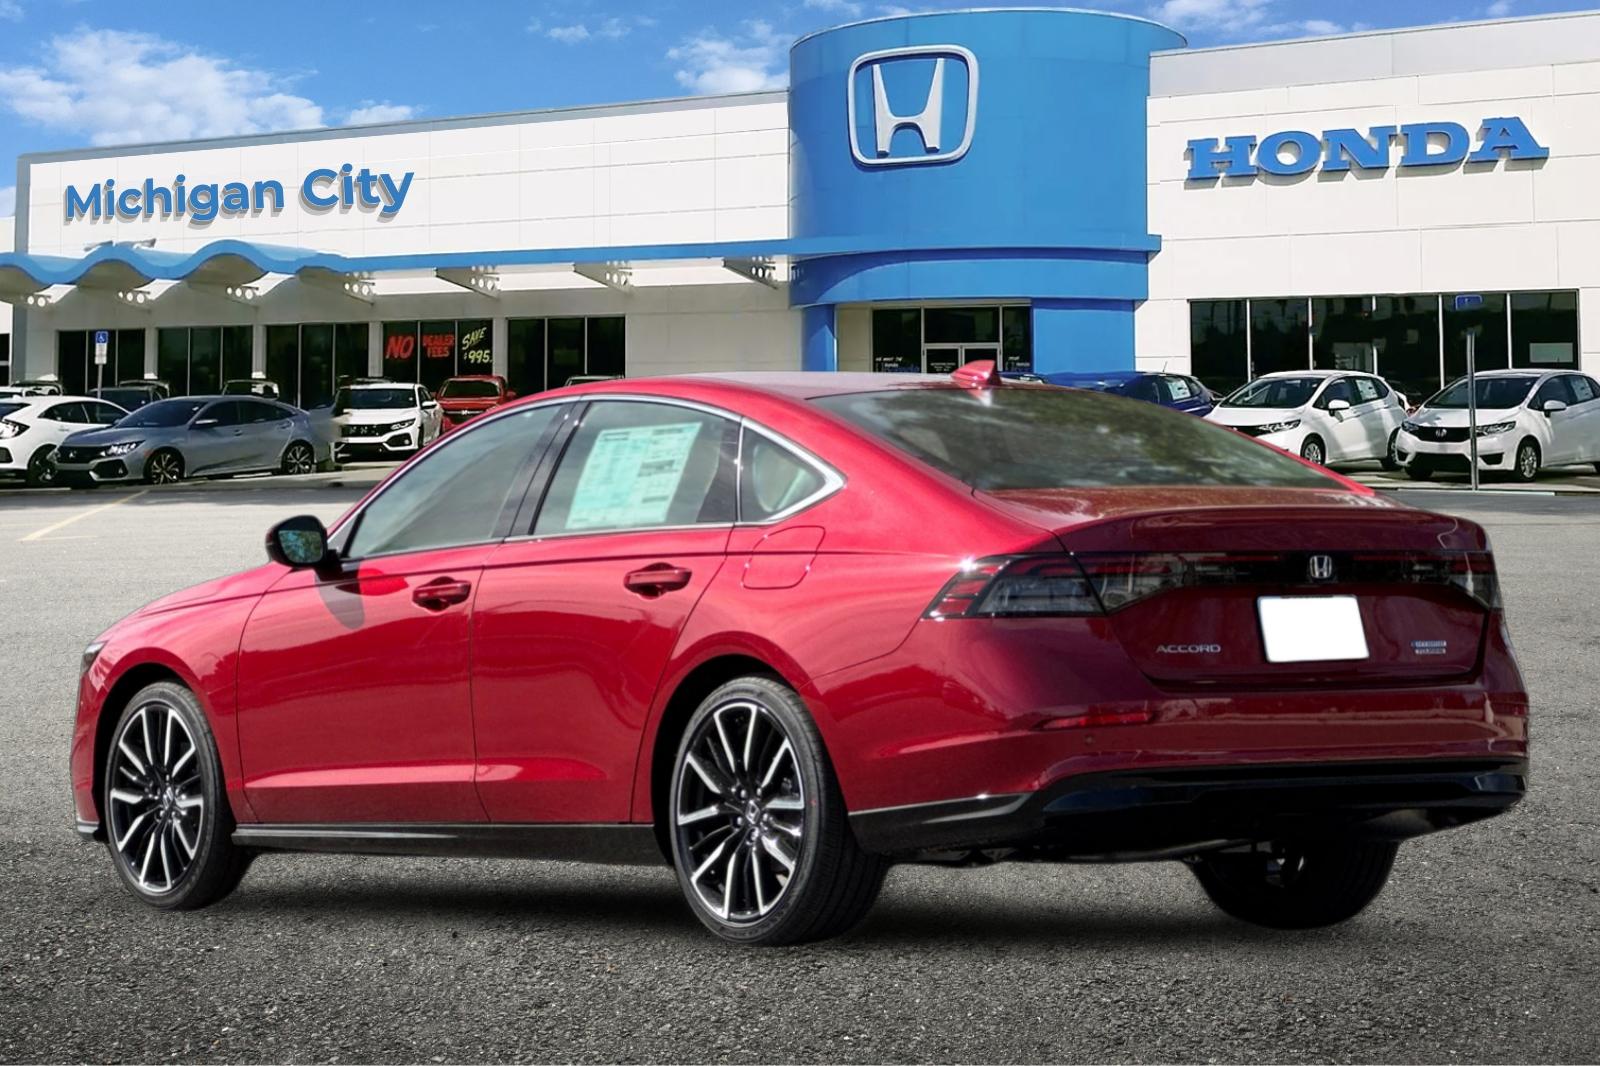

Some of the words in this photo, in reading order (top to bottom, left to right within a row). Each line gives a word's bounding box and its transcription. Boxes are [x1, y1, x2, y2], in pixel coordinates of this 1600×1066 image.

[1186, 116, 1549, 182] HONDA
[65, 174, 284, 222] Michigan
[302, 163, 415, 215] City
[385, 335, 415, 359] NO
[462, 327, 487, 350] SAVE
[1155, 643, 1222, 654] ACCORD
